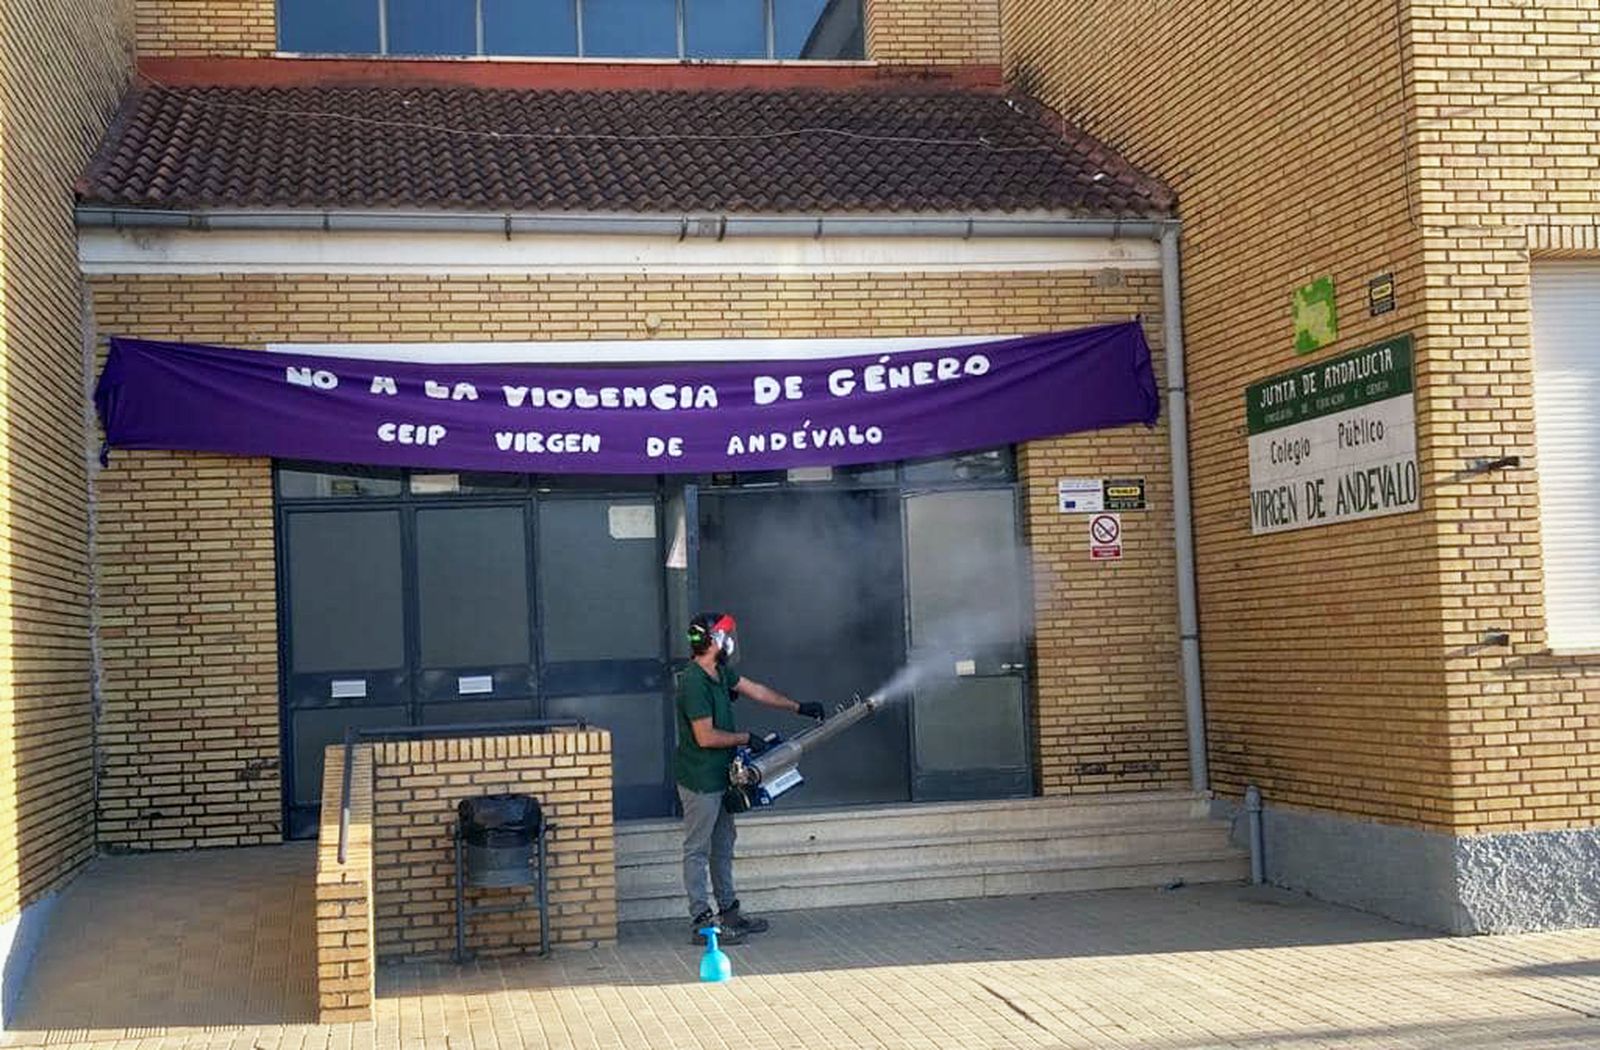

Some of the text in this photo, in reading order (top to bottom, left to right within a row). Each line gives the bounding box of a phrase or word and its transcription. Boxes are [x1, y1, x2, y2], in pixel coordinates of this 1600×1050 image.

[286, 355, 990, 410] NO A LA VIOLENCIA DE GÉNERO
[1260, 379, 1296, 408] JUNTA
[1302, 371, 1316, 395] DE
[377, 419, 883, 457] CEIP VIRGEN DE ANDÉVALO
[1271, 419, 1384, 465] Colegio Público
[1251, 460, 1417, 527] VIRGEN DE ANDEVALO
